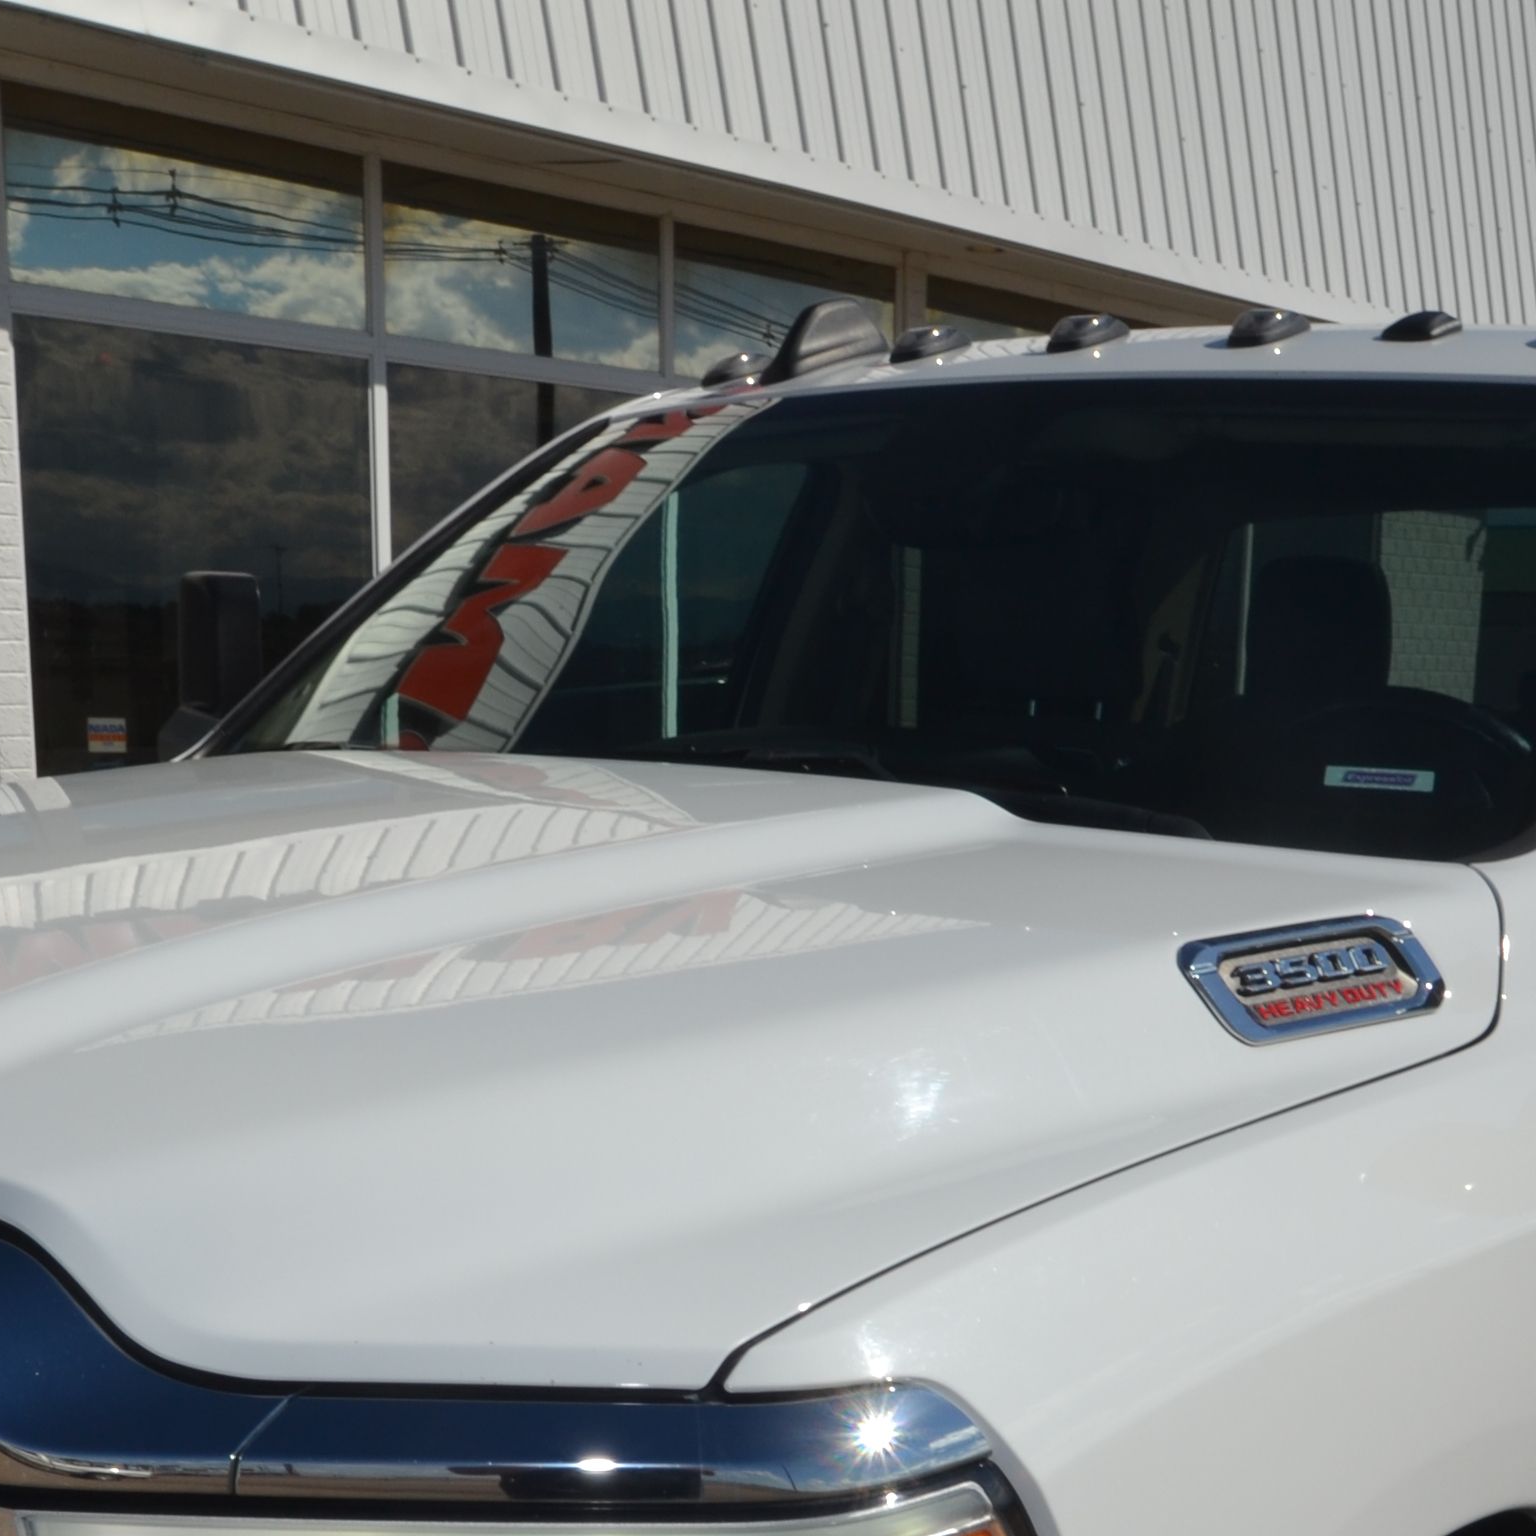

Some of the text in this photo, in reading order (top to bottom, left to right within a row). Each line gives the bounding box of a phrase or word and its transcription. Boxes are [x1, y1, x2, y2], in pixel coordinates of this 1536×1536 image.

[1230, 943, 1390, 997] 3500
[1255, 979, 1404, 1021] HEAVY DUTY
